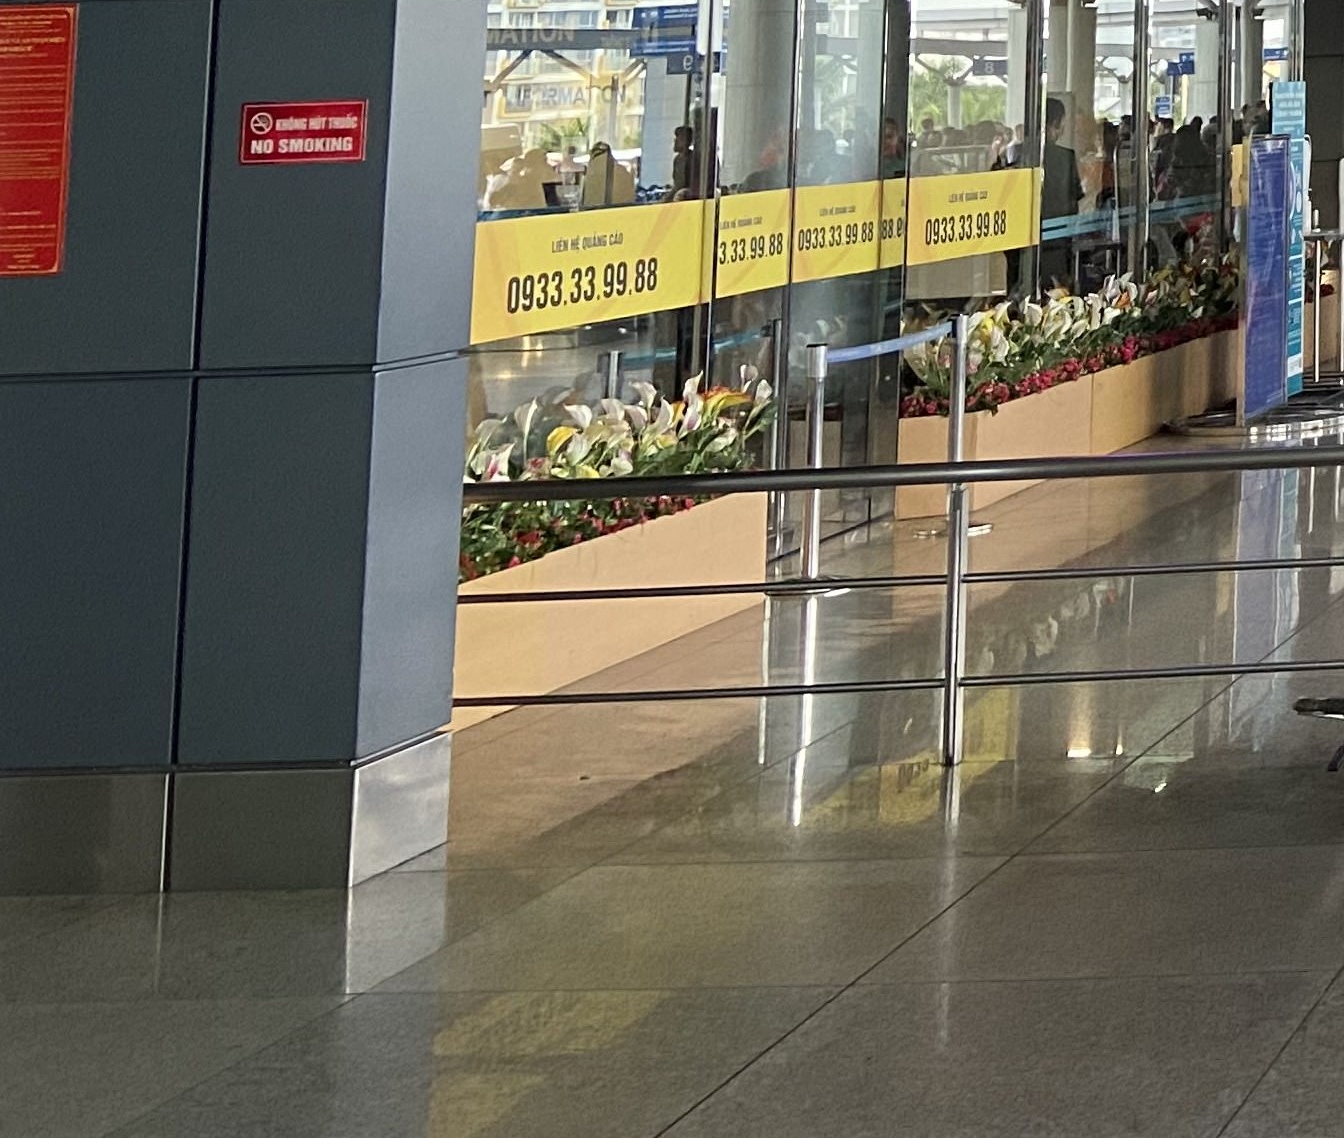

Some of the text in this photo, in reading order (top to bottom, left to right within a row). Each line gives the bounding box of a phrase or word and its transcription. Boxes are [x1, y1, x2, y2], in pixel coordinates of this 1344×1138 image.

[250, 137, 353, 154] NO SMOKING
[798, 221, 874, 251] 0933.33.99.88
[925, 210, 1007, 245] 0933.33.99.88
[507, 257, 658, 314] 0933.33.99.88
